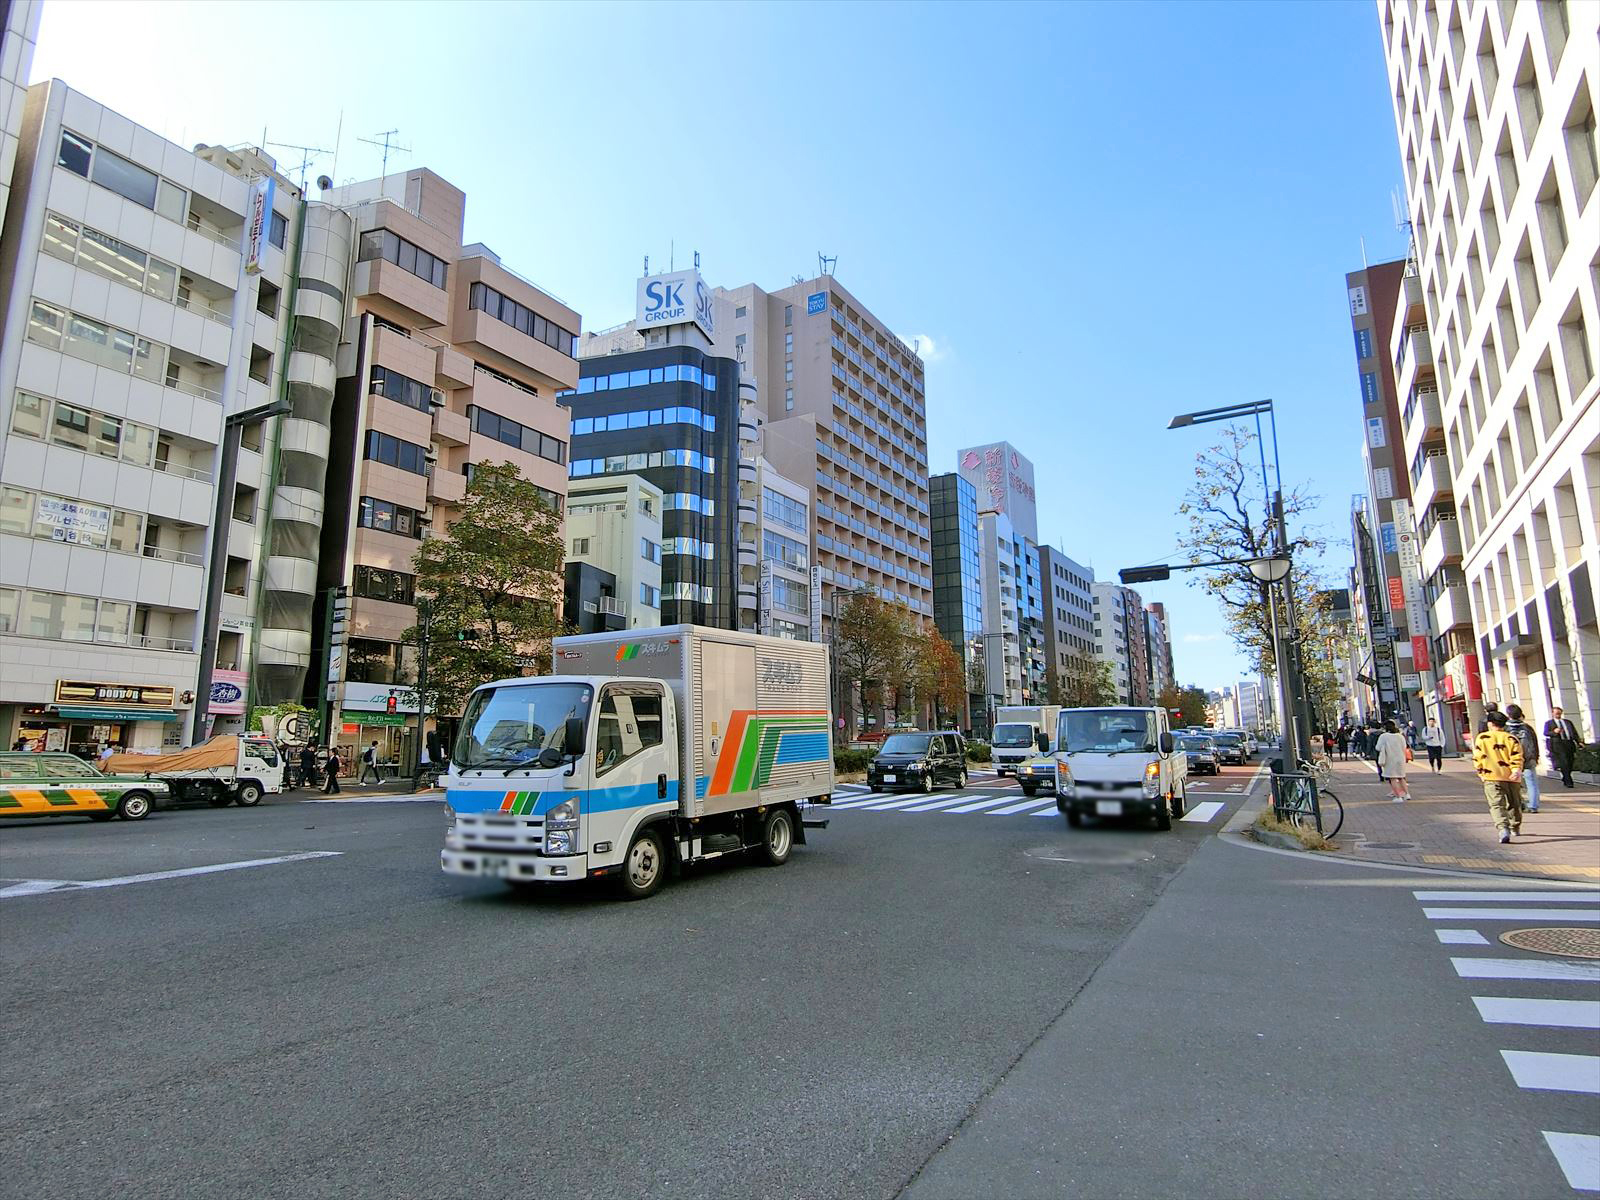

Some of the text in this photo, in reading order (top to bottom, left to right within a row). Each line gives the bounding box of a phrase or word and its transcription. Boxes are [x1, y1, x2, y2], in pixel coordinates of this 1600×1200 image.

[645, 280, 685, 312] SK
[696, 281, 713, 325] SK
[99, 687, 139, 700] DOUTOR
